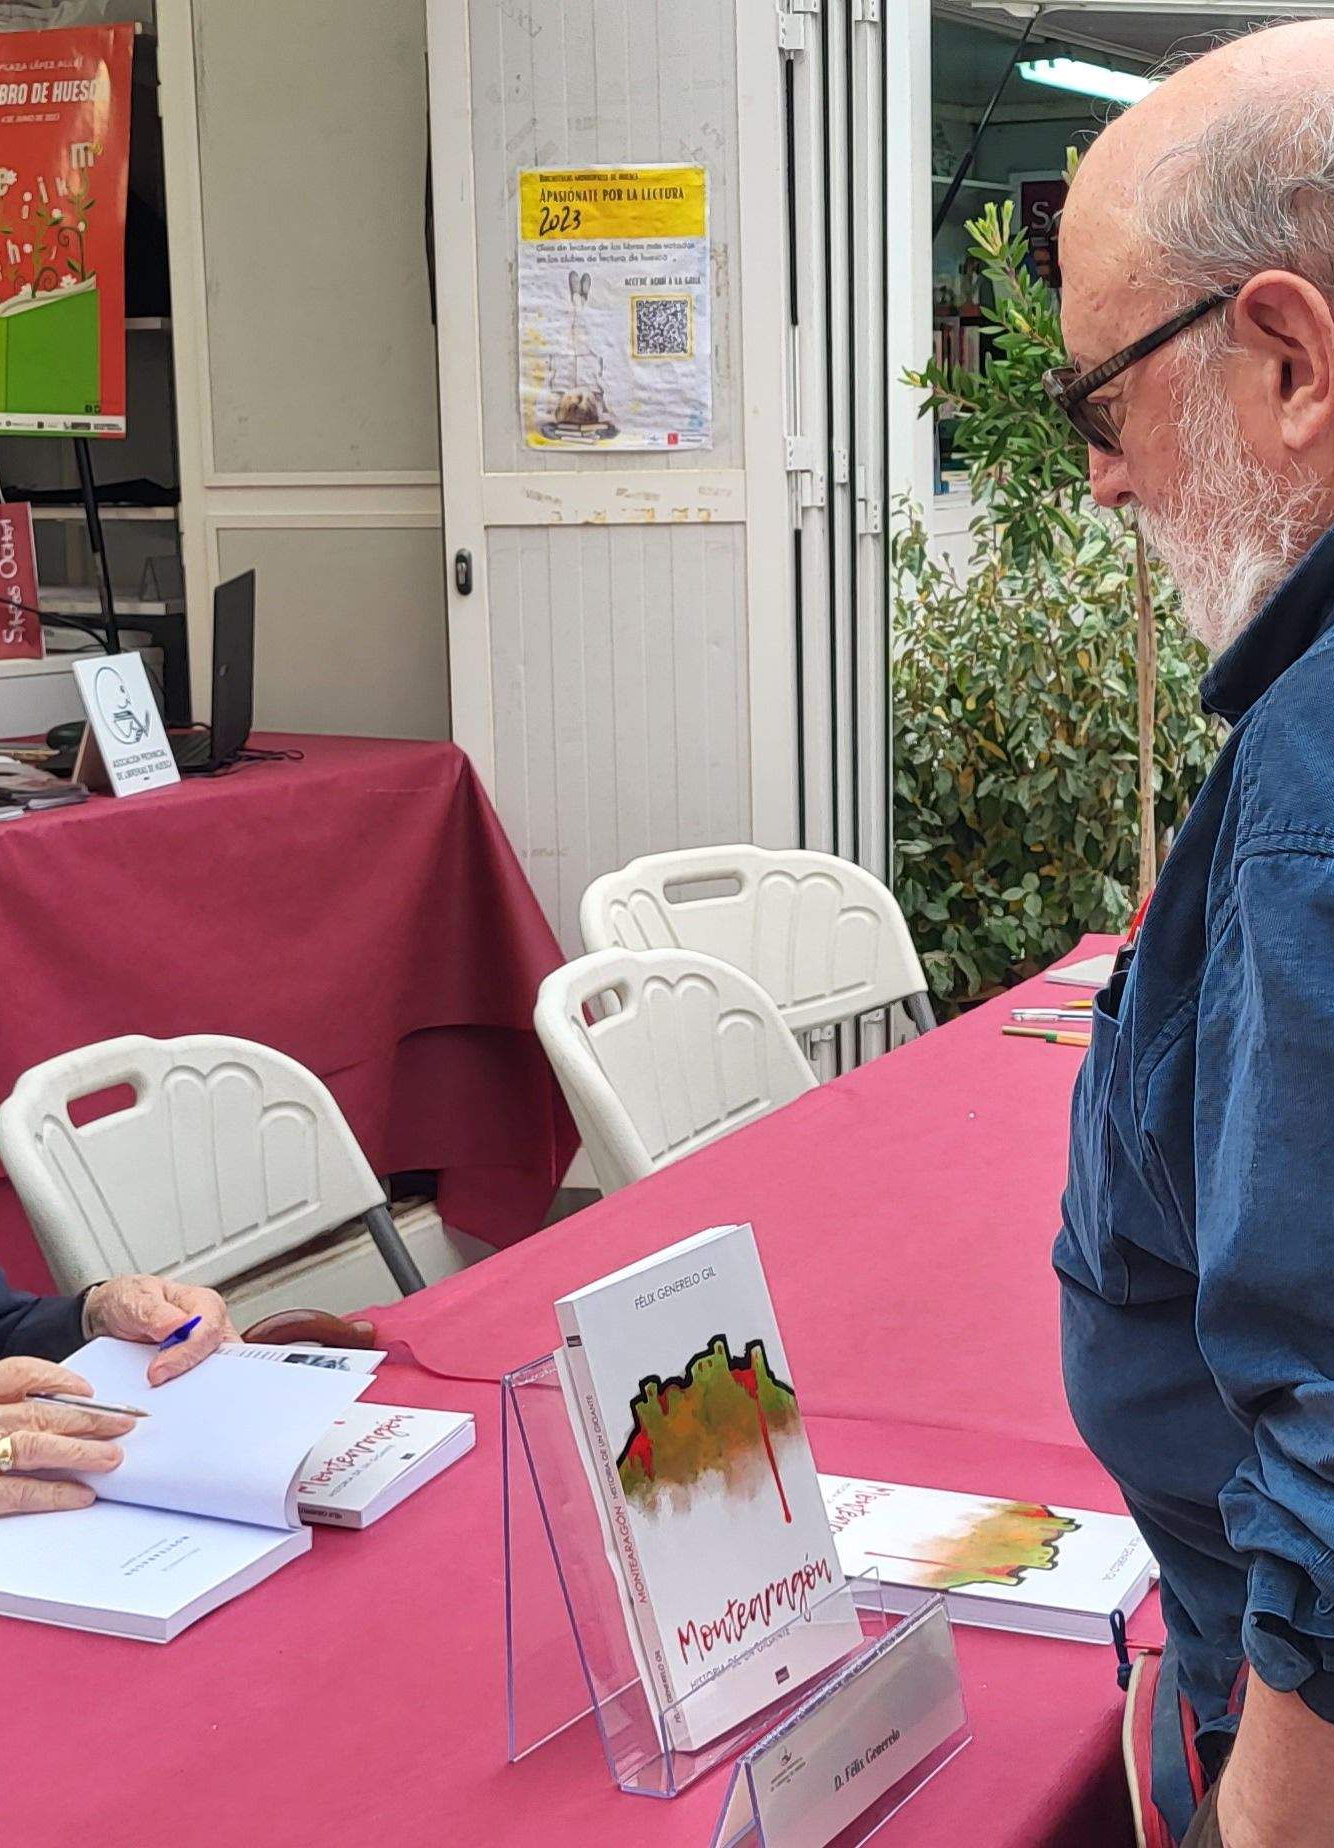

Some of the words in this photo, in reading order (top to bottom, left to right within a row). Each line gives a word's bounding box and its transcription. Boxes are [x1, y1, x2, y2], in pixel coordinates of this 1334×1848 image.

[30, 81, 49, 104] DE
[602, 188, 623, 203] POR
[626, 187, 638, 201] LA
[641, 186, 685, 201] LECTURA
[538, 205, 582, 237] 2023
[634, 1291, 656, 1310] FÉLIX
[657, 1272, 701, 1300] GENERELO
[701, 1265, 717, 1281] GIL
[614, 1505, 647, 1604] MONTEARAGÓN
[677, 1551, 832, 1666] Montearagón
[833, 1774, 845, 1793] D.
[845, 1757, 866, 1782] Félix
[865, 1728, 901, 1765] Generelo
